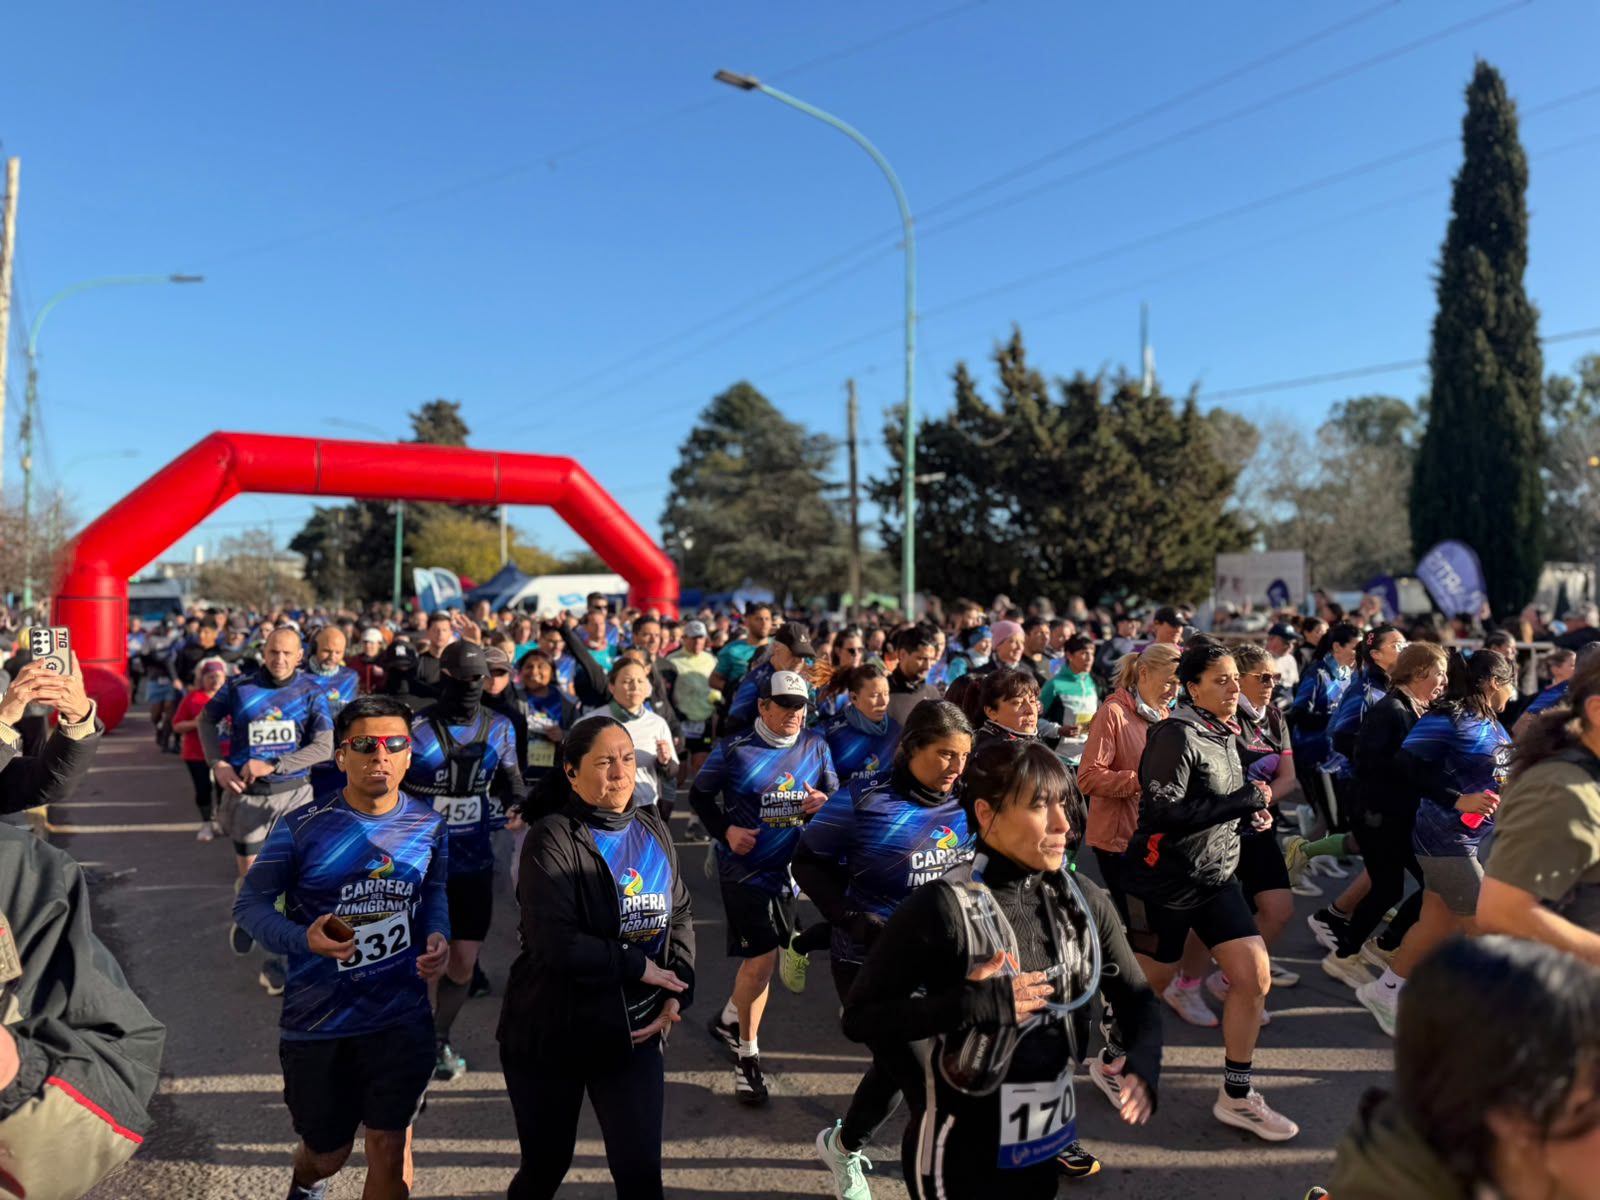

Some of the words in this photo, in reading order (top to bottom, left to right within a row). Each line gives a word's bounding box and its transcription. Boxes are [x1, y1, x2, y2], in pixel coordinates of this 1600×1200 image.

[58, 631, 68, 649] TIG
[252, 727, 292, 744] 540
[851, 770, 881, 779] CARR
[761, 791, 809, 806] CARRERA
[440, 802, 479, 822] 452
[760, 806, 803, 817] INMIGRA
[912, 849, 976, 870] CARR
[341, 879, 414, 901] CARRERA
[335, 899, 412, 915] INMIGRAN
[622, 893, 667, 914] RRERA
[629, 912, 641, 920] DEL
[1009, 1085, 1074, 1141] 170
